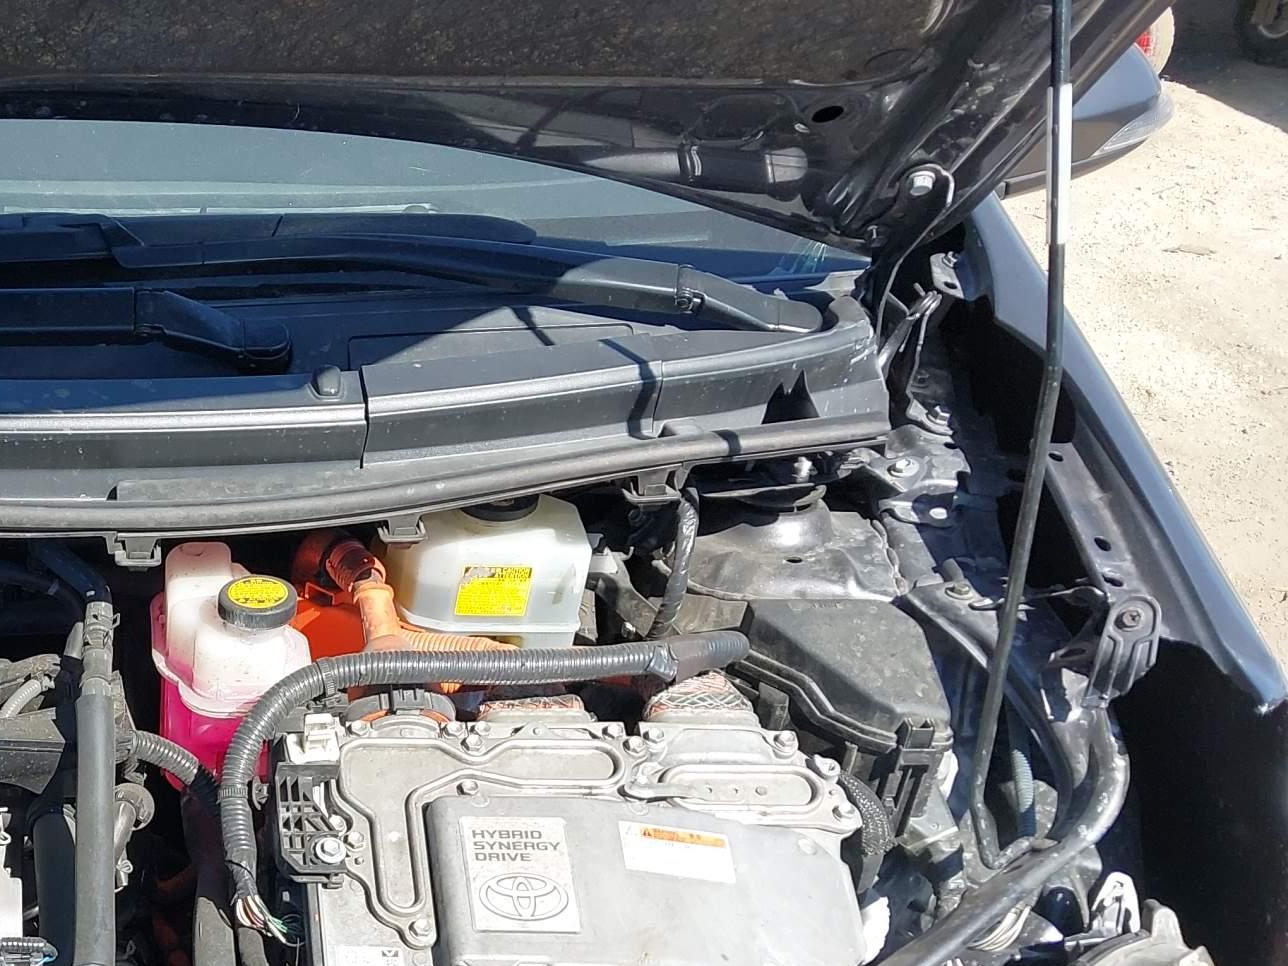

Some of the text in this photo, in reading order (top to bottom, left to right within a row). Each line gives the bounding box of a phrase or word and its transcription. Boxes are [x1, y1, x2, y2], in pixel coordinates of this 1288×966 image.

[472, 830, 542, 839] HYBRID
[473, 841, 560, 850] SYNERGY
[474, 853, 532, 861] DRIVE
